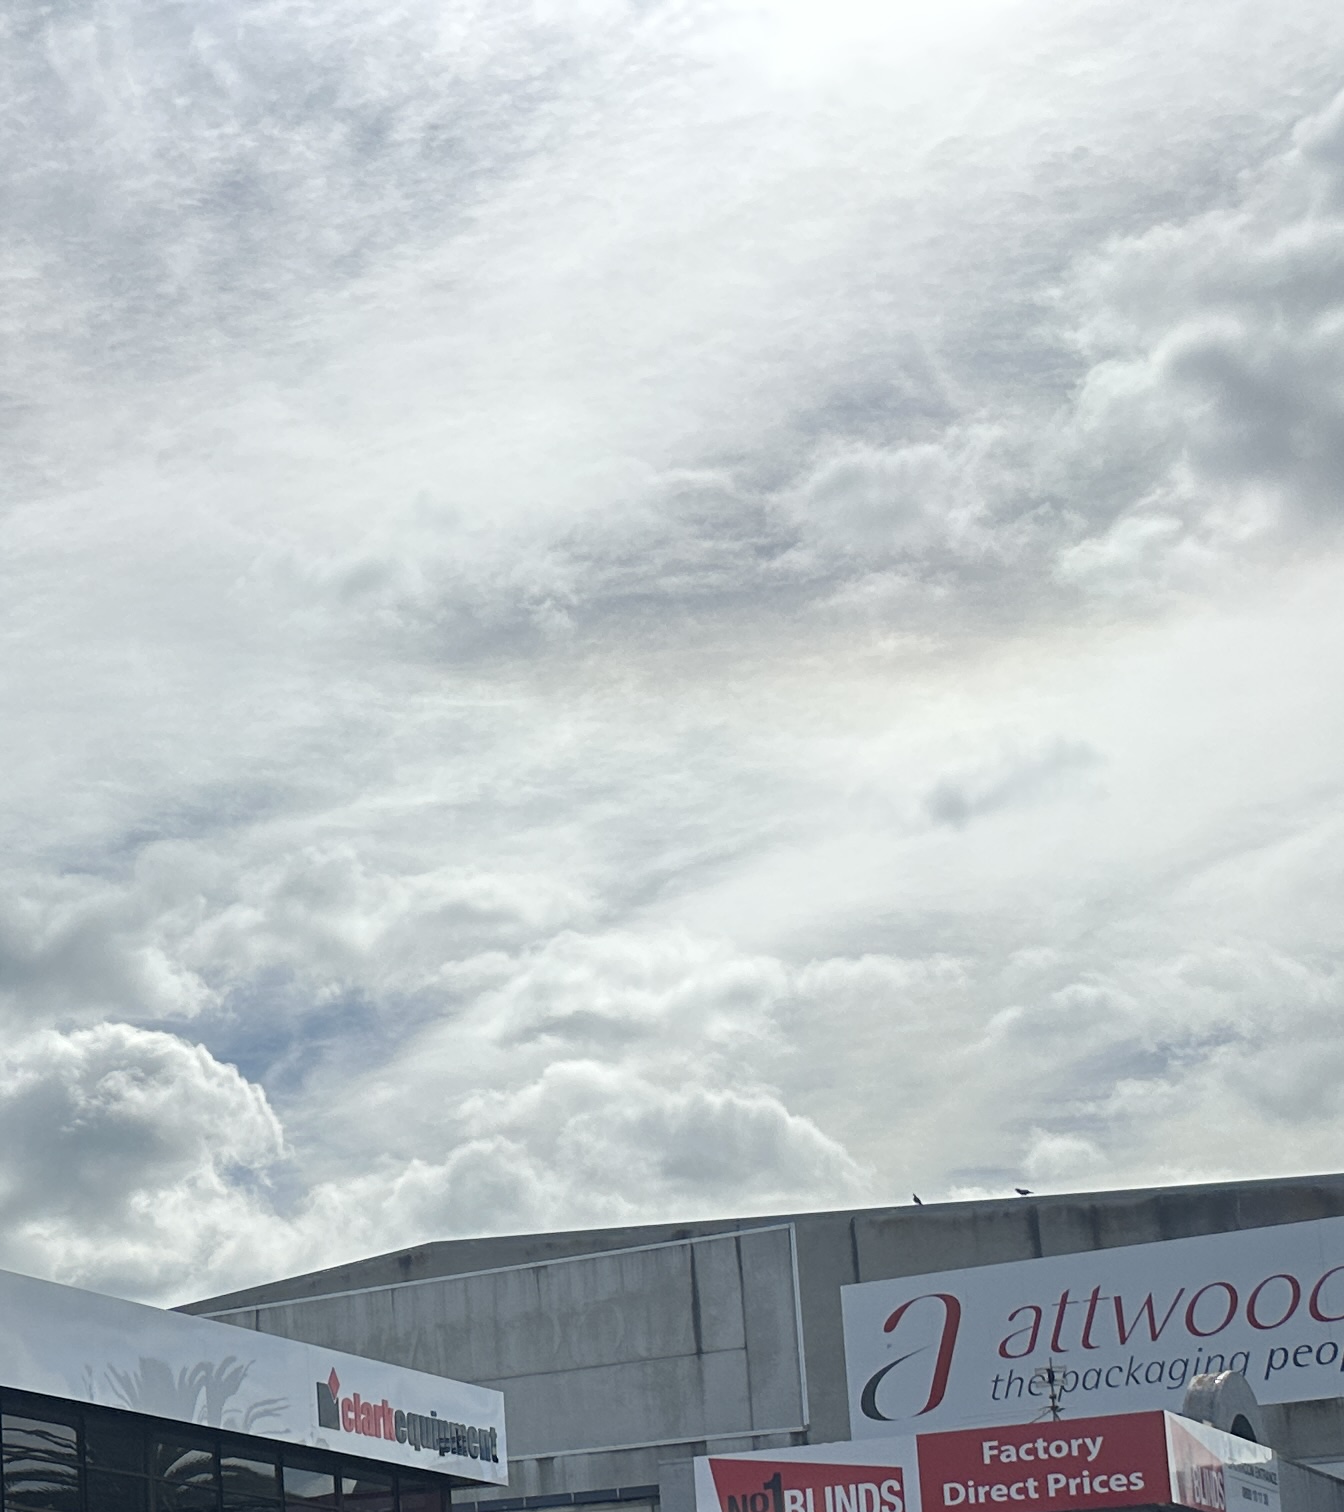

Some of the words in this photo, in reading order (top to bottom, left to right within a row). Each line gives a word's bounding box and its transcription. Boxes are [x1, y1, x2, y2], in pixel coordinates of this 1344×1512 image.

[991, 1368, 1050, 1400] the
[1263, 1339, 1344, 1381] peo
[983, 1435, 1104, 1465] Factory
[943, 1477, 1039, 1506] Direct
[1047, 1470, 1146, 1499] Prices
